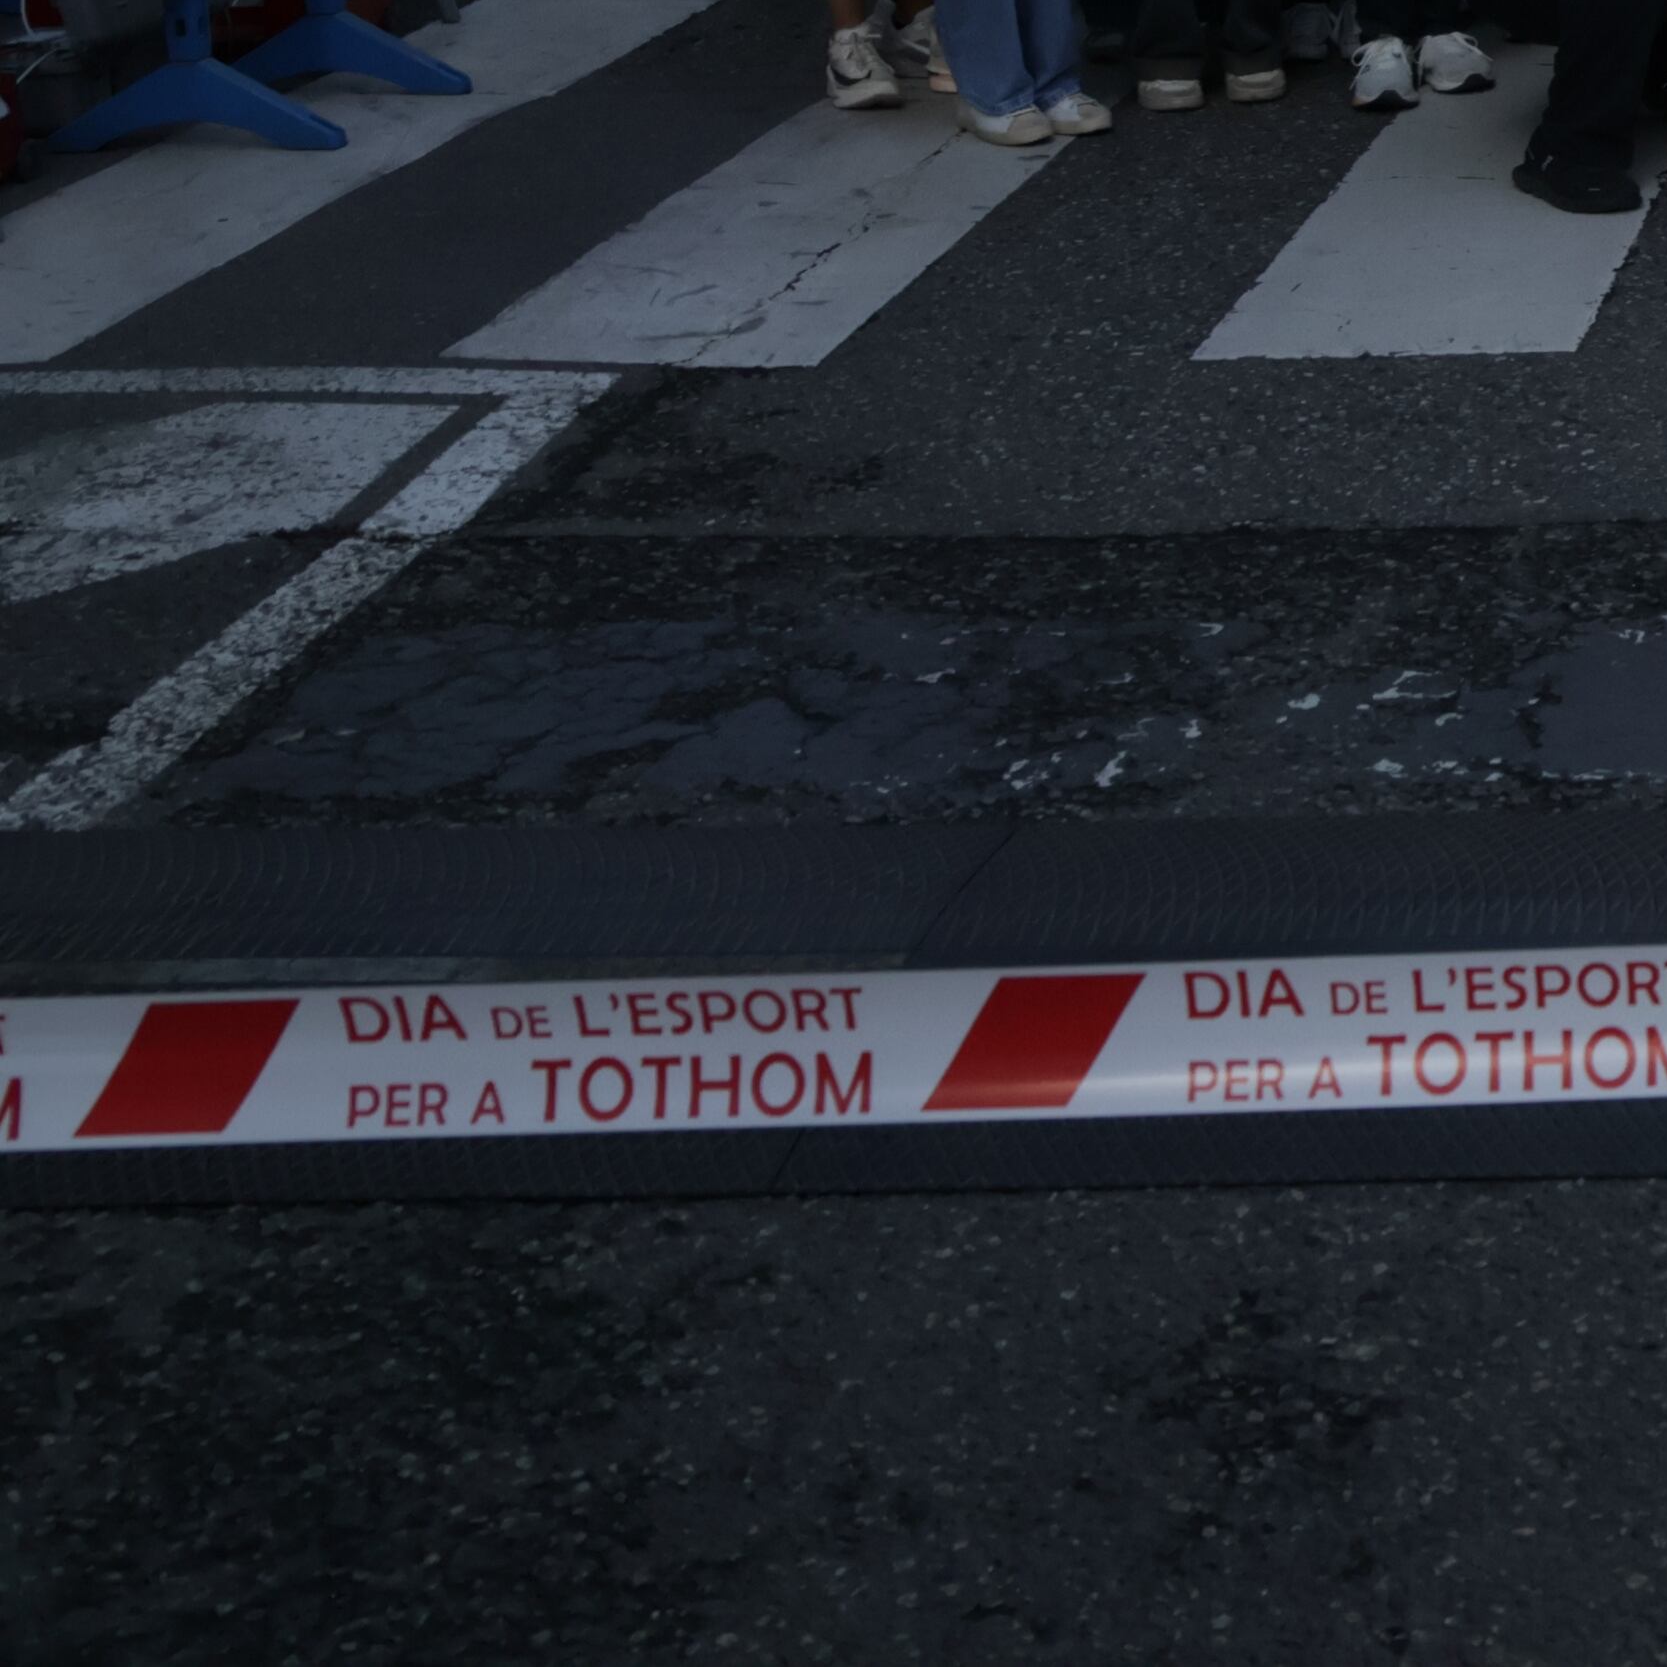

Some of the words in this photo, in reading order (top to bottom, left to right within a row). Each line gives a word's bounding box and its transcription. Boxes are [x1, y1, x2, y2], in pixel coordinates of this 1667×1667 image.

[339, 994, 467, 1044] DIA
[492, 1007, 551, 1040] DE
[574, 987, 863, 1038] L'ESPORT
[1185, 969, 1303, 1019] DIA
[1331, 982, 1384, 1015] DE
[348, 1083, 447, 1128] PER
[471, 1082, 505, 1125] A
[532, 1051, 874, 1123] TOTHOM
[1189, 1060, 1282, 1101] PER
[1311, 1062, 1340, 1096] A
